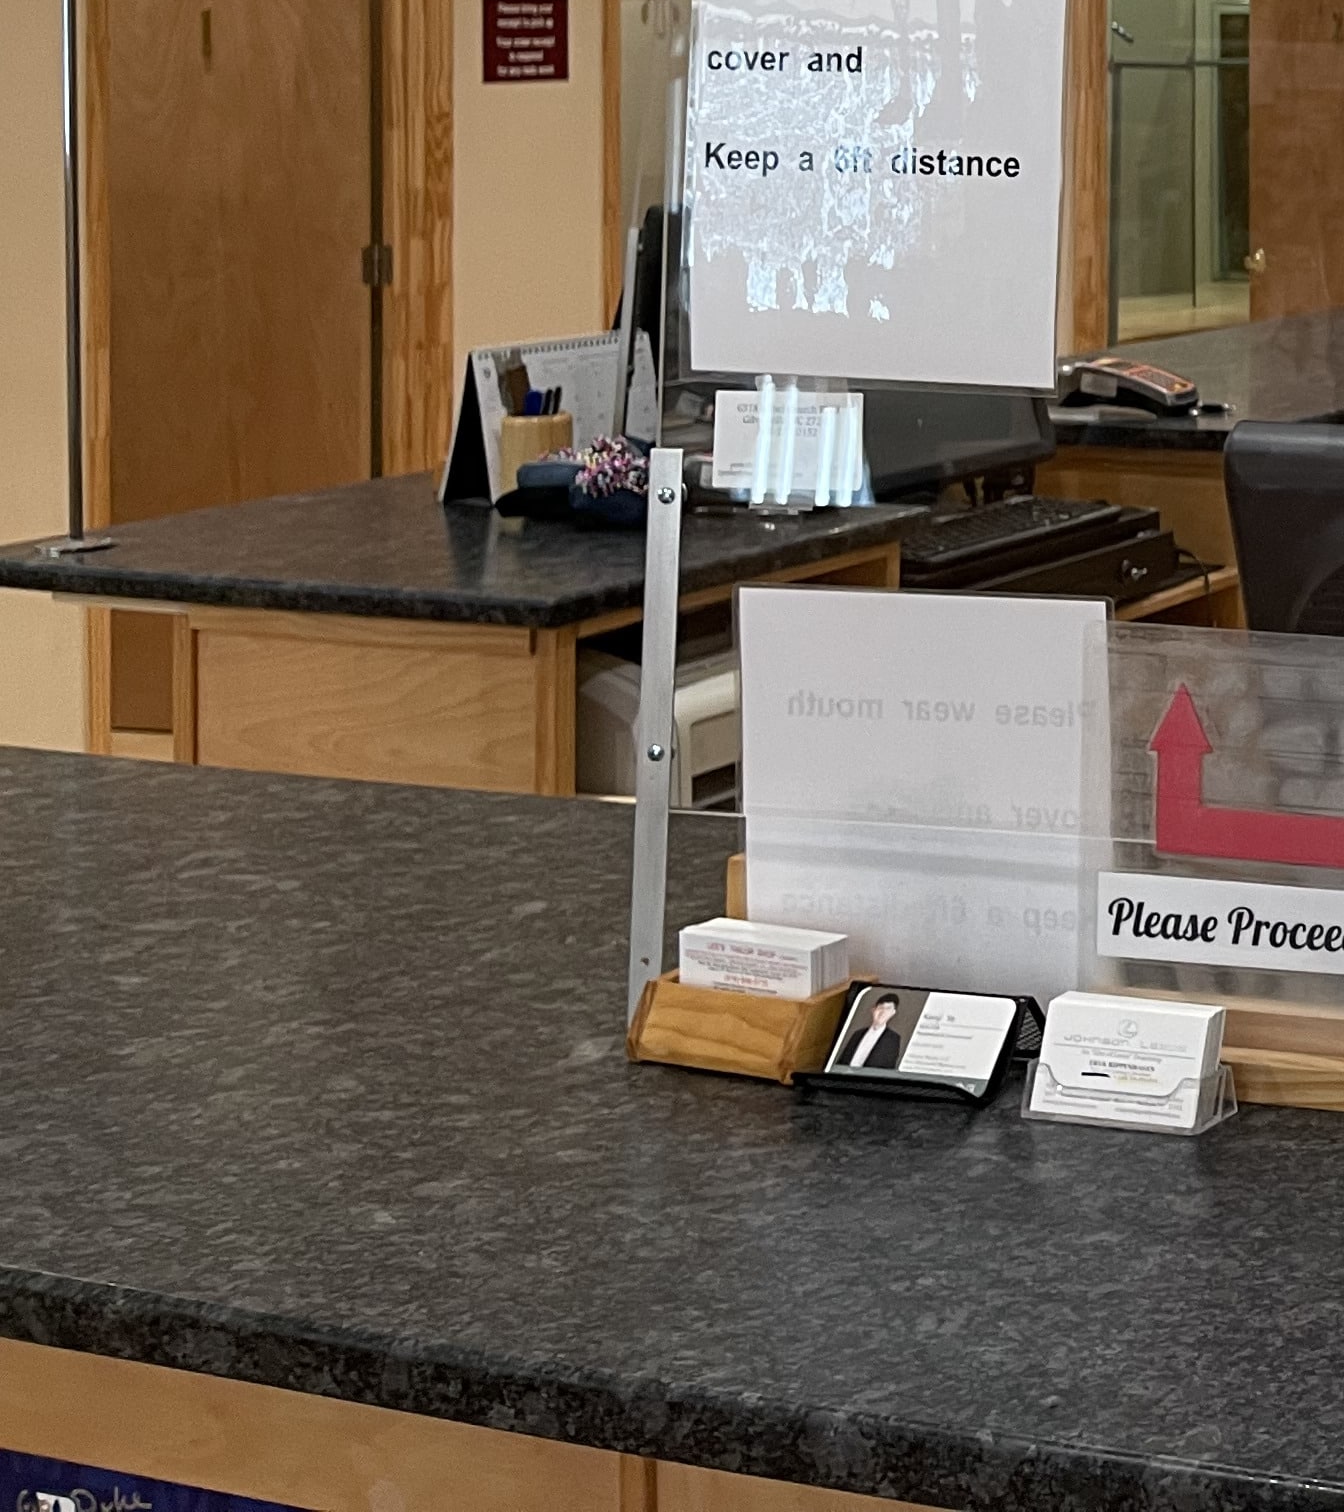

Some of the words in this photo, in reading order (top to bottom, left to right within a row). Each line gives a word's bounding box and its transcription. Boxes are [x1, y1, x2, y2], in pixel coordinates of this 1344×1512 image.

[707, 50, 790, 72] cover
[807, 46, 863, 73] and
[704, 142, 780, 177] Keep
[799, 150, 814, 172] a
[891, 147, 1021, 178] distance
[1107, 897, 1219, 942] Please
